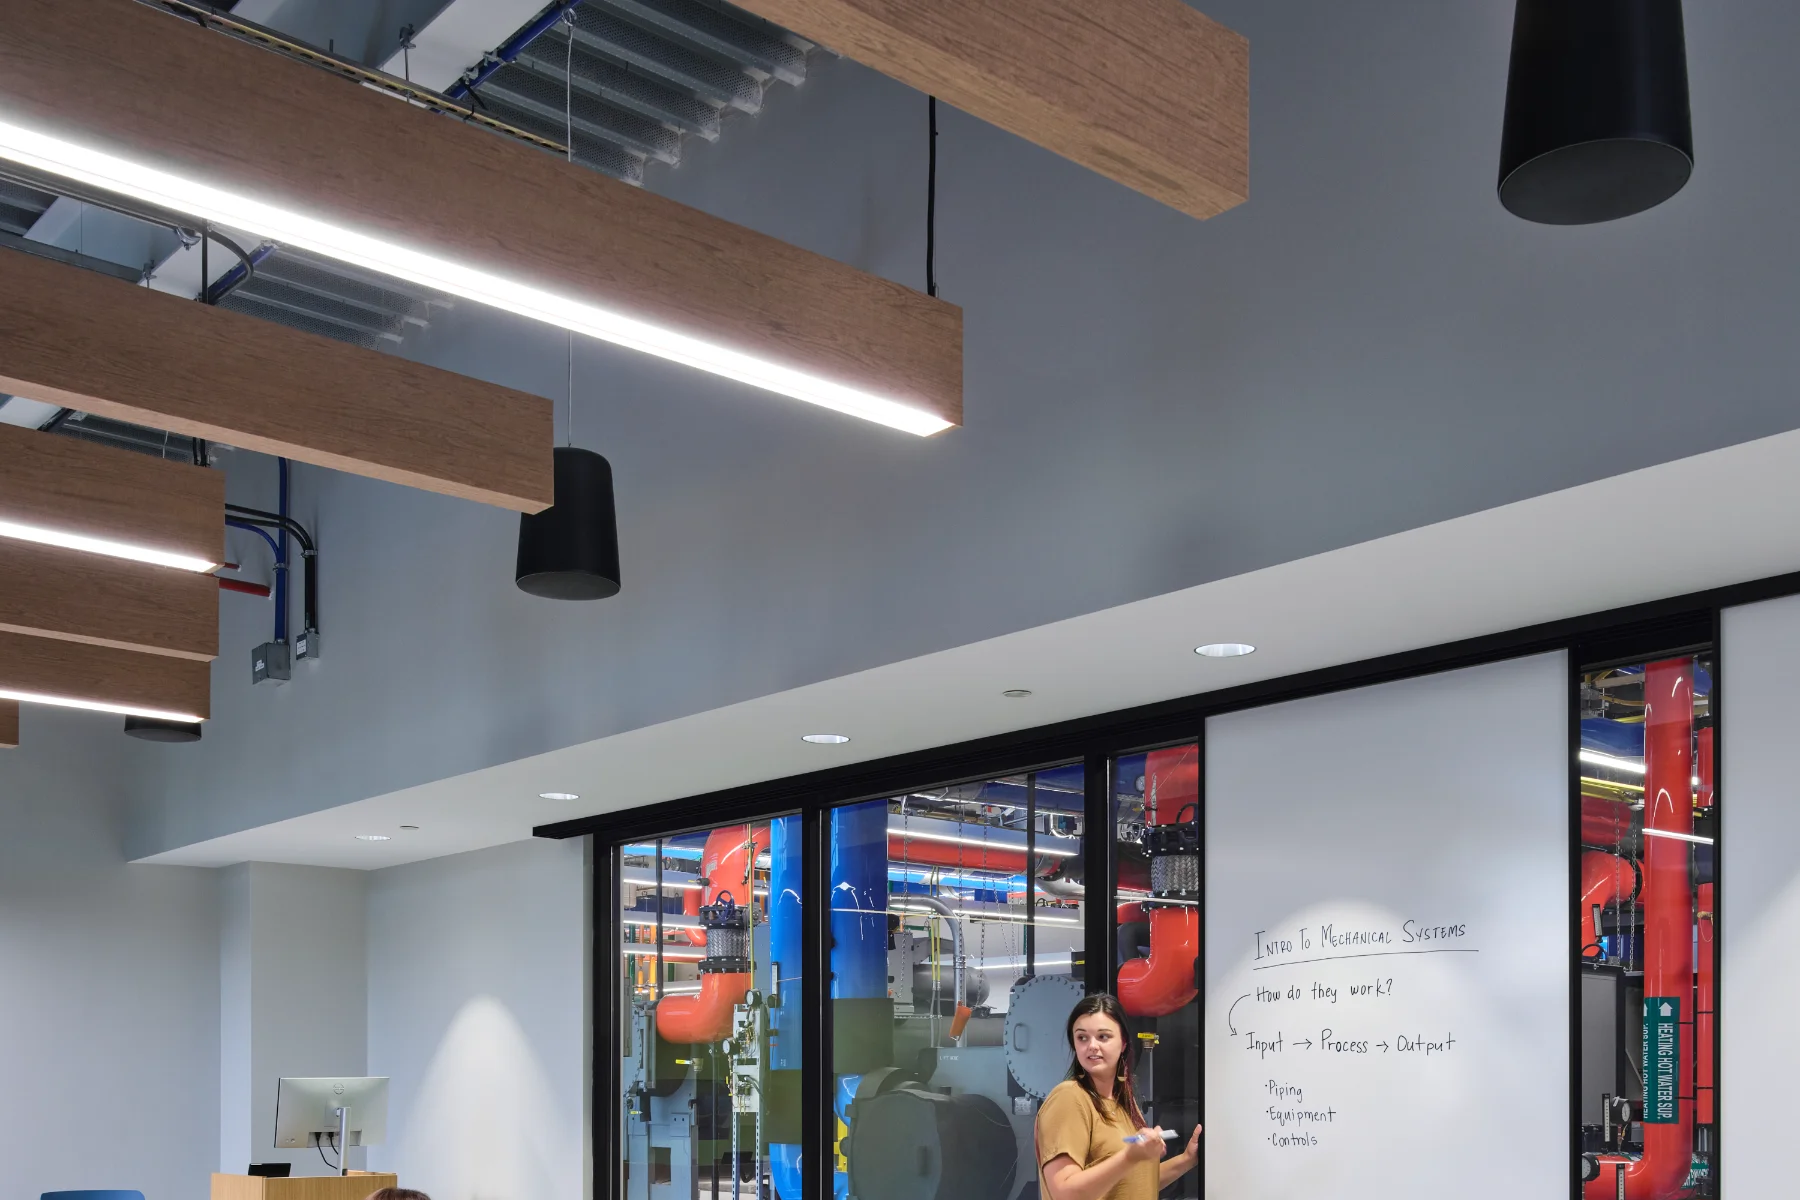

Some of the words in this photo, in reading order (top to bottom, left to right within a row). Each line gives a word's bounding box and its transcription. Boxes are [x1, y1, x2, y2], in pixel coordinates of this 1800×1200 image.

[1256, 985, 1281, 1003] How
[1287, 984, 1301, 1000] do
[1311, 981, 1338, 1003] they
[1350, 978, 1393, 997] work?
[1245, 1031, 1284, 1060] Input
[1321, 1028, 1369, 1053] Process
[1397, 1032, 1456, 1056] Output
[1657, 1023, 1673, 1056] HEATING
[1657, 1057, 1673, 1074] HOT
[1268, 1079, 1303, 1103] Piping
[1657, 1074, 1673, 1102] WATER
[1269, 1106, 1337, 1127] Equipment
[1656, 1102, 1673, 1120] SUP.
[1272, 1131, 1318, 1147] Controls
